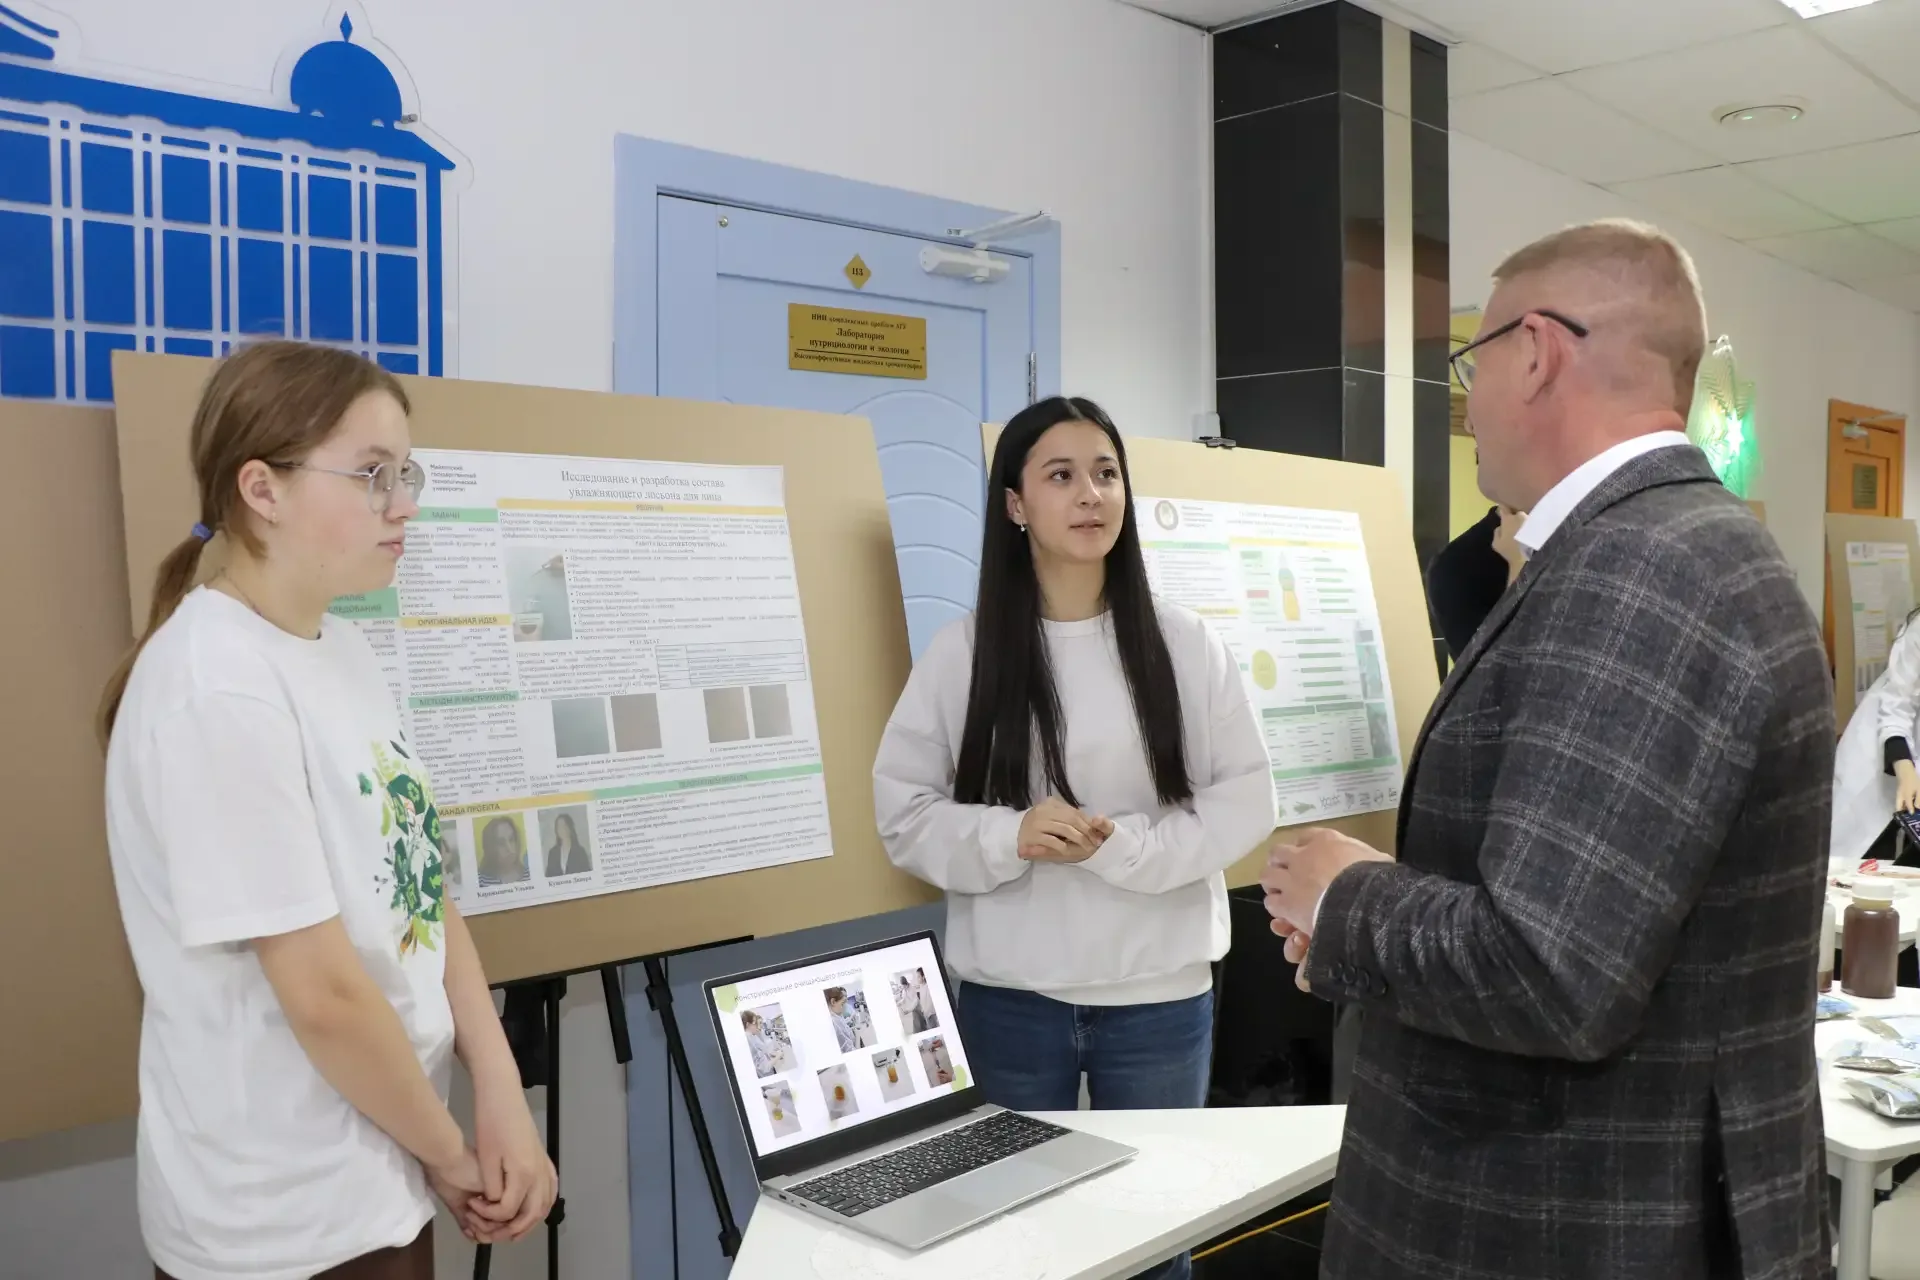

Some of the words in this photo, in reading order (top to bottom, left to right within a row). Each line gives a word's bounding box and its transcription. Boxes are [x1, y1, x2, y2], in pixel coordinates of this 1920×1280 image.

[852, 267, 864, 277] 113
[811, 313, 827, 322] НИИ
[836, 328, 885, 342] Лаборатория
[809, 339, 867, 352] нутрициологии
[876, 347, 910, 356] экологии
[561, 470, 630, 484] Исследование
[640, 476, 689, 487] разработка
[691, 479, 726, 488] состава
[569, 488, 643, 501] увлажняющего
[644, 491, 681, 501] лосьона
[683, 493, 699, 502] для
[701, 493, 722, 502] лица
[418, 616, 478, 627] ОРИГИНАЛЬНАЯ
[478, 615, 498, 624] ИДЕЯ
[467, 803, 500, 813] ПРОЕКТА
[734, 983, 793, 1003] Конструирование
[794, 972, 837, 990] очищающего
[837, 966, 864, 978] лосьона
